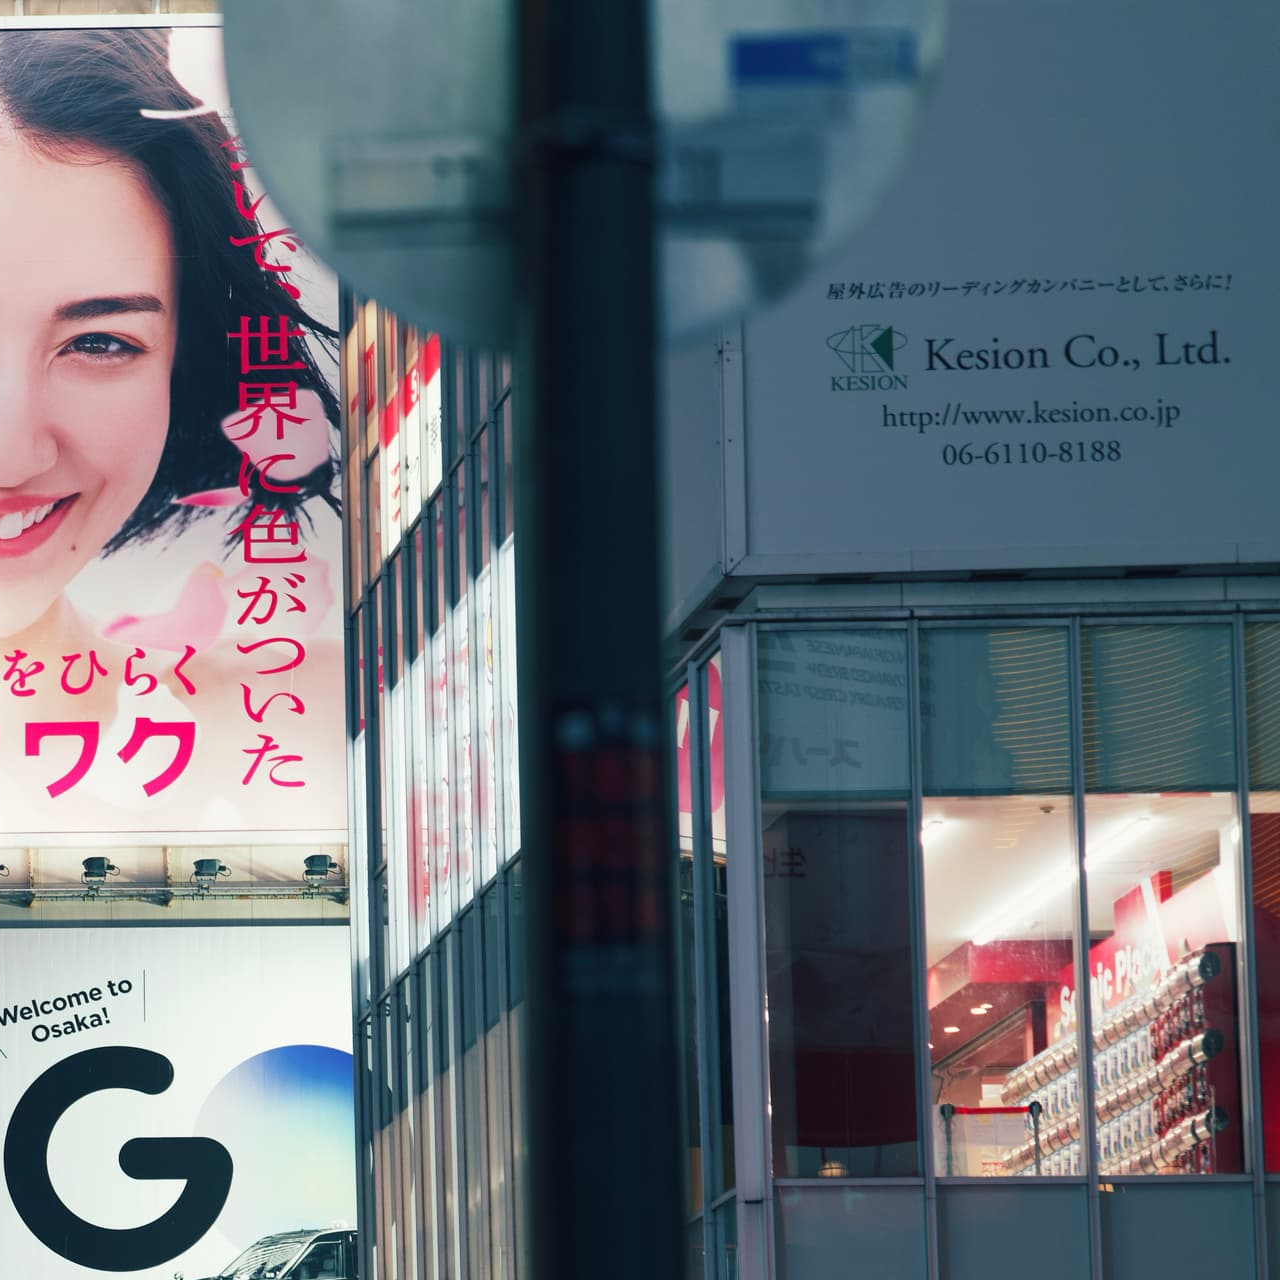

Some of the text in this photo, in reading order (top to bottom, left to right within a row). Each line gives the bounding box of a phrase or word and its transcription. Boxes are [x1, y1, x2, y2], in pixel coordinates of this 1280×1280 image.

[924, 330, 1232, 372] Kesion Co., Ltd.
[830, 374, 909, 392] KESION
[881, 397, 1182, 434] http://www.kesion.co.jp
[942, 440, 1122, 465] 06-6110-8188
[106, 979, 133, 997] to
[31, 1007, 111, 1043] Osaka!
